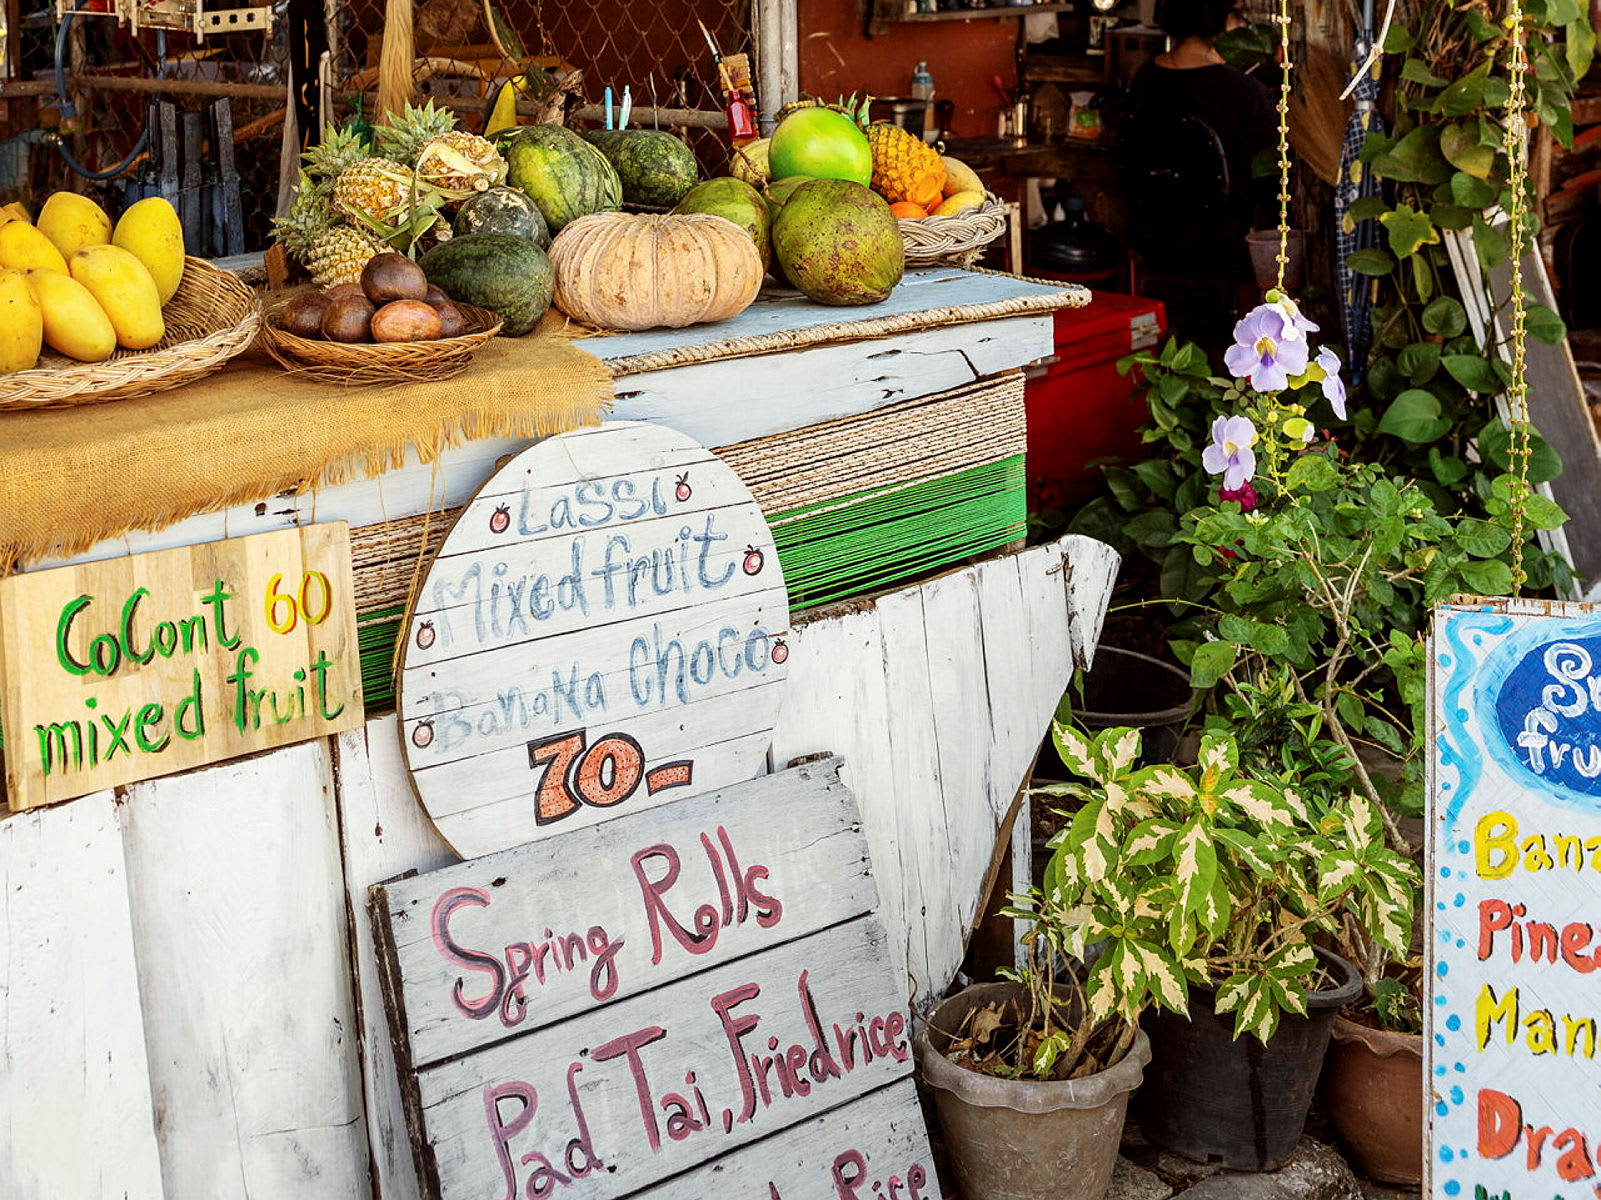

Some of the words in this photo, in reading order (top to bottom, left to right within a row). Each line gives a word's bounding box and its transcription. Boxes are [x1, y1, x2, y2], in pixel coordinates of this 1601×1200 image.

[265, 571, 332, 635] 60
[33, 668, 206, 776] mixed
[226, 647, 345, 737] fruit
[430, 886, 625, 1029] Spring
[630, 825, 783, 965] Rolls
[1476, 898, 1601, 975] Pine
[1474, 983, 1601, 1060] Man
[482, 1060, 608, 1200] Pad
